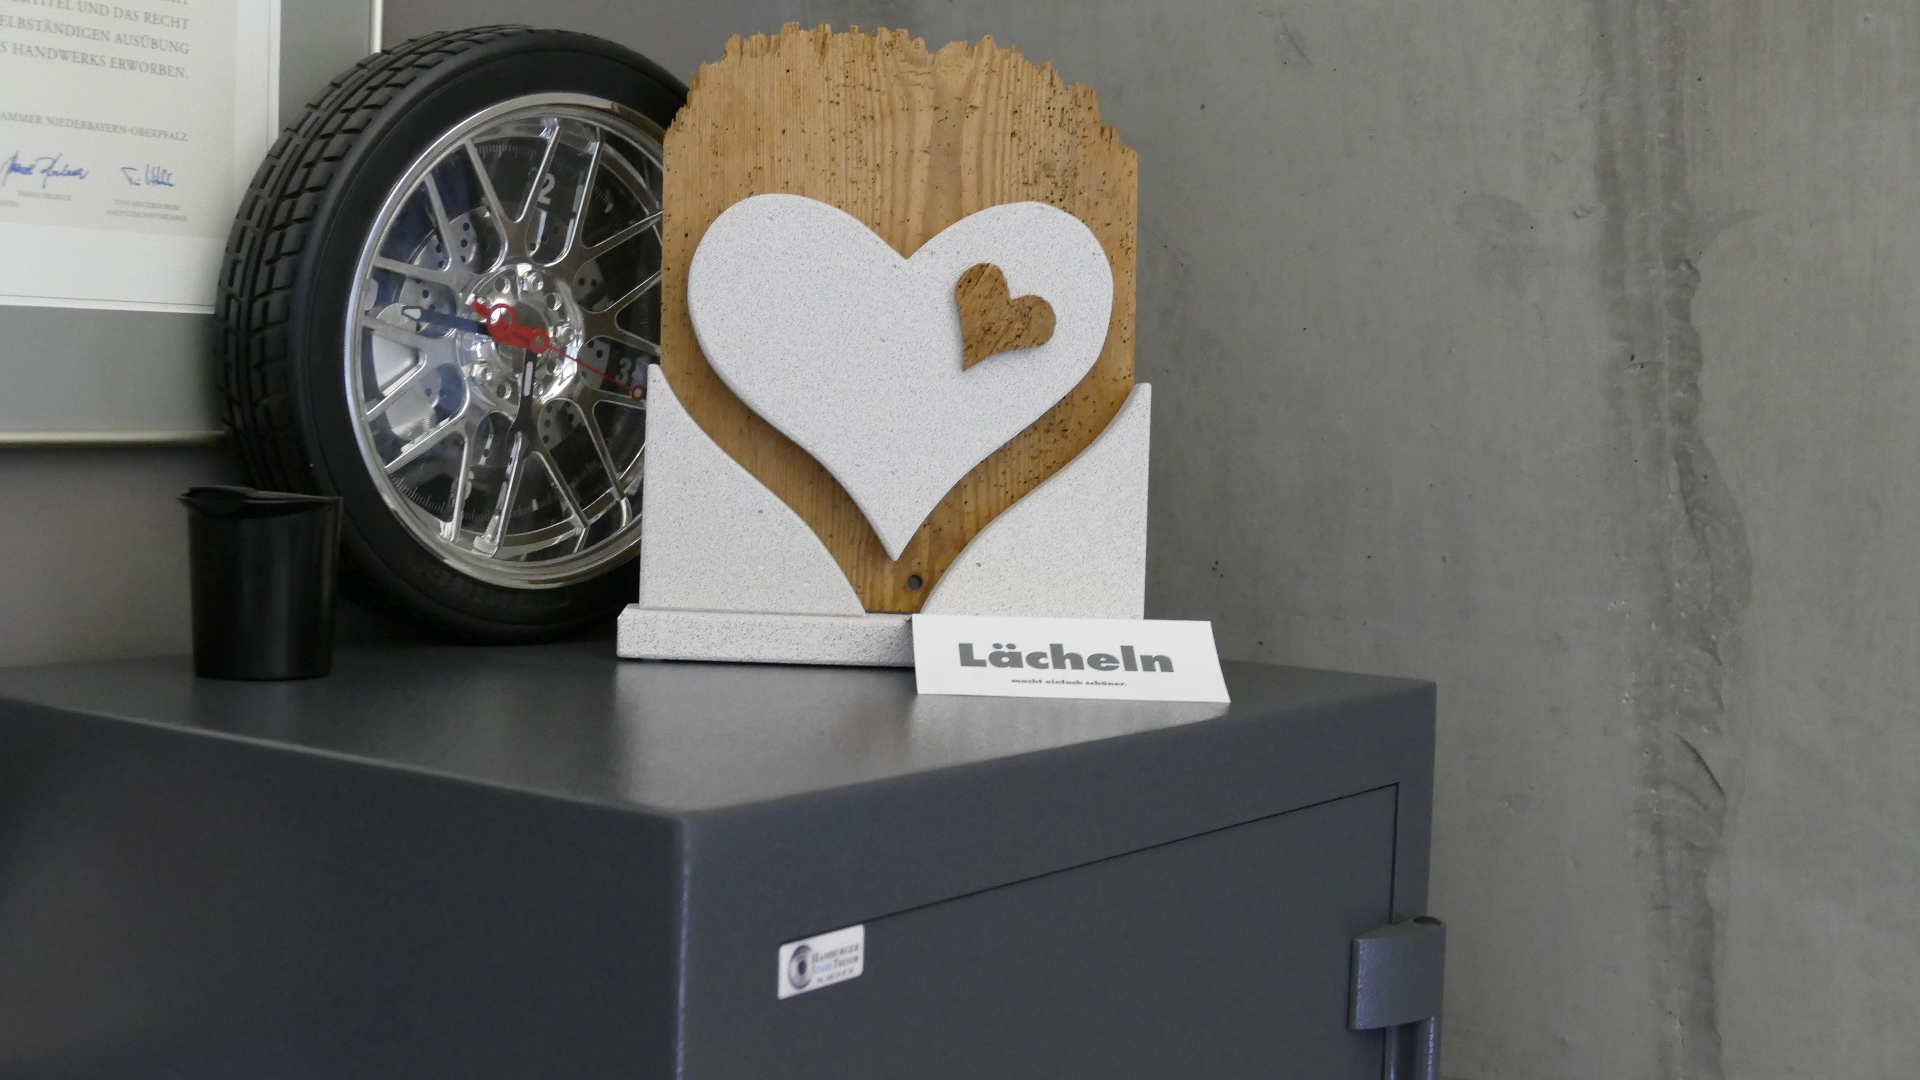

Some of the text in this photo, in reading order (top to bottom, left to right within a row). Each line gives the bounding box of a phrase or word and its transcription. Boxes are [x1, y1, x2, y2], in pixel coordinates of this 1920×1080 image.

[77, 0, 109, 16] UND
[114, 6, 140, 22] DAS
[144, 11, 190, 30] RECHT
[114, 32, 190, 55] AUSÜBUNG
[12, 42, 106, 67] HANDWERKS
[110, 56, 189, 78] ERWORBEN.
[46, 116, 188, 142] NIEDERBAYERN-OBERPFALZ
[958, 642, 1175, 673] Lächeln
